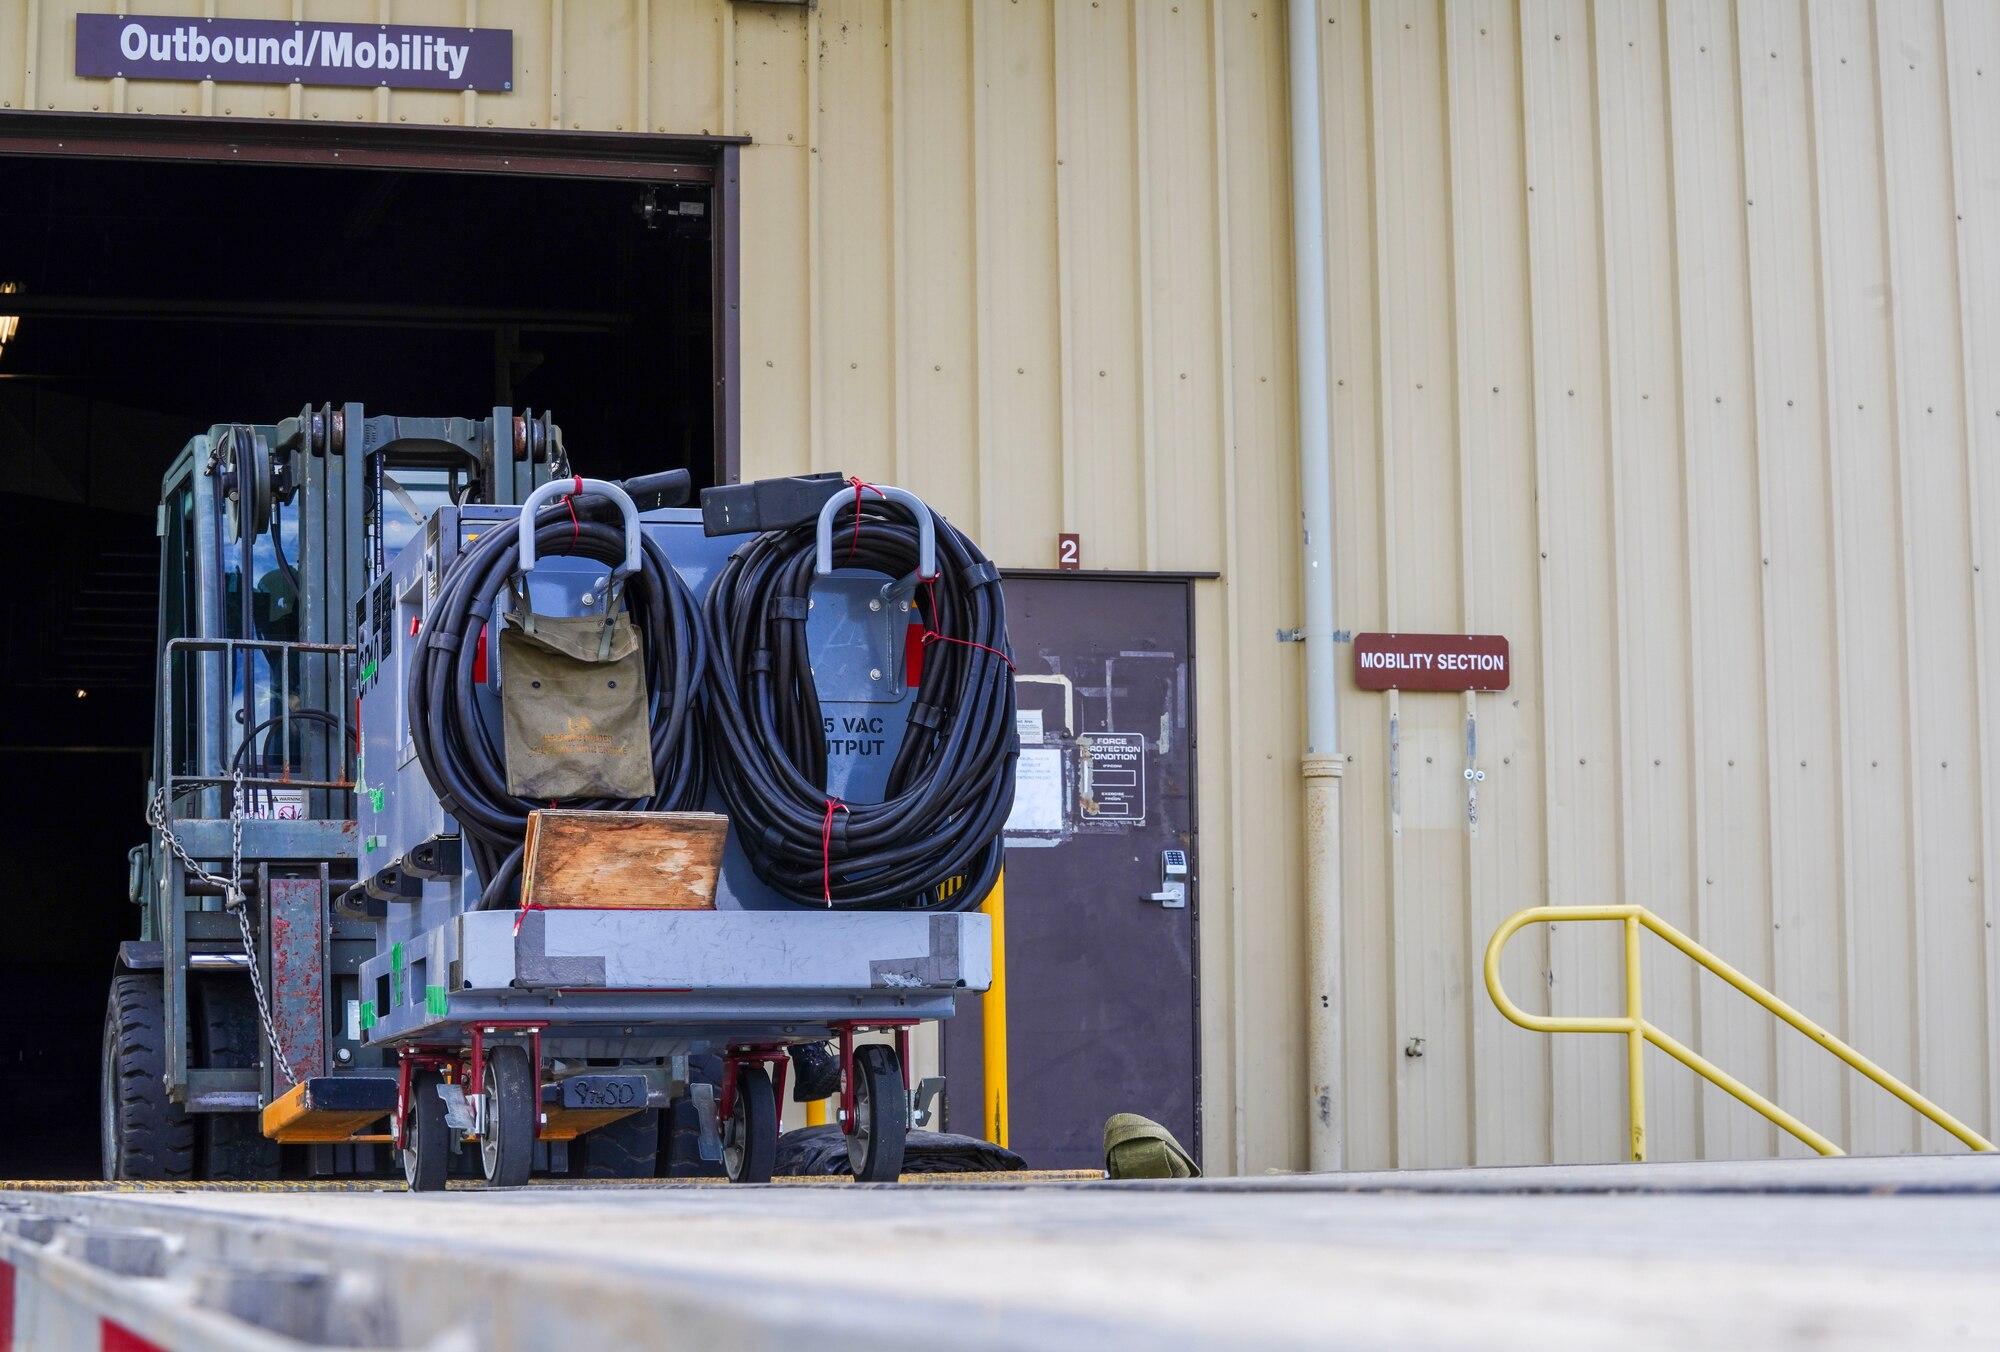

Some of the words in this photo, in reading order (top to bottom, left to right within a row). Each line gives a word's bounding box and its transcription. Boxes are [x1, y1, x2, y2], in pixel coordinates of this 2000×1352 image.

[120, 23, 470, 80] Outbound/Mobility
[1061, 539, 1078, 563] 2
[1361, 652, 1433, 669] MOBILITY
[1437, 653, 1504, 670] SECTION
[842, 717, 884, 734] VAC
[1088, 745, 1141, 753] ROTECTION
[1097, 737, 1127, 745] FORCE
